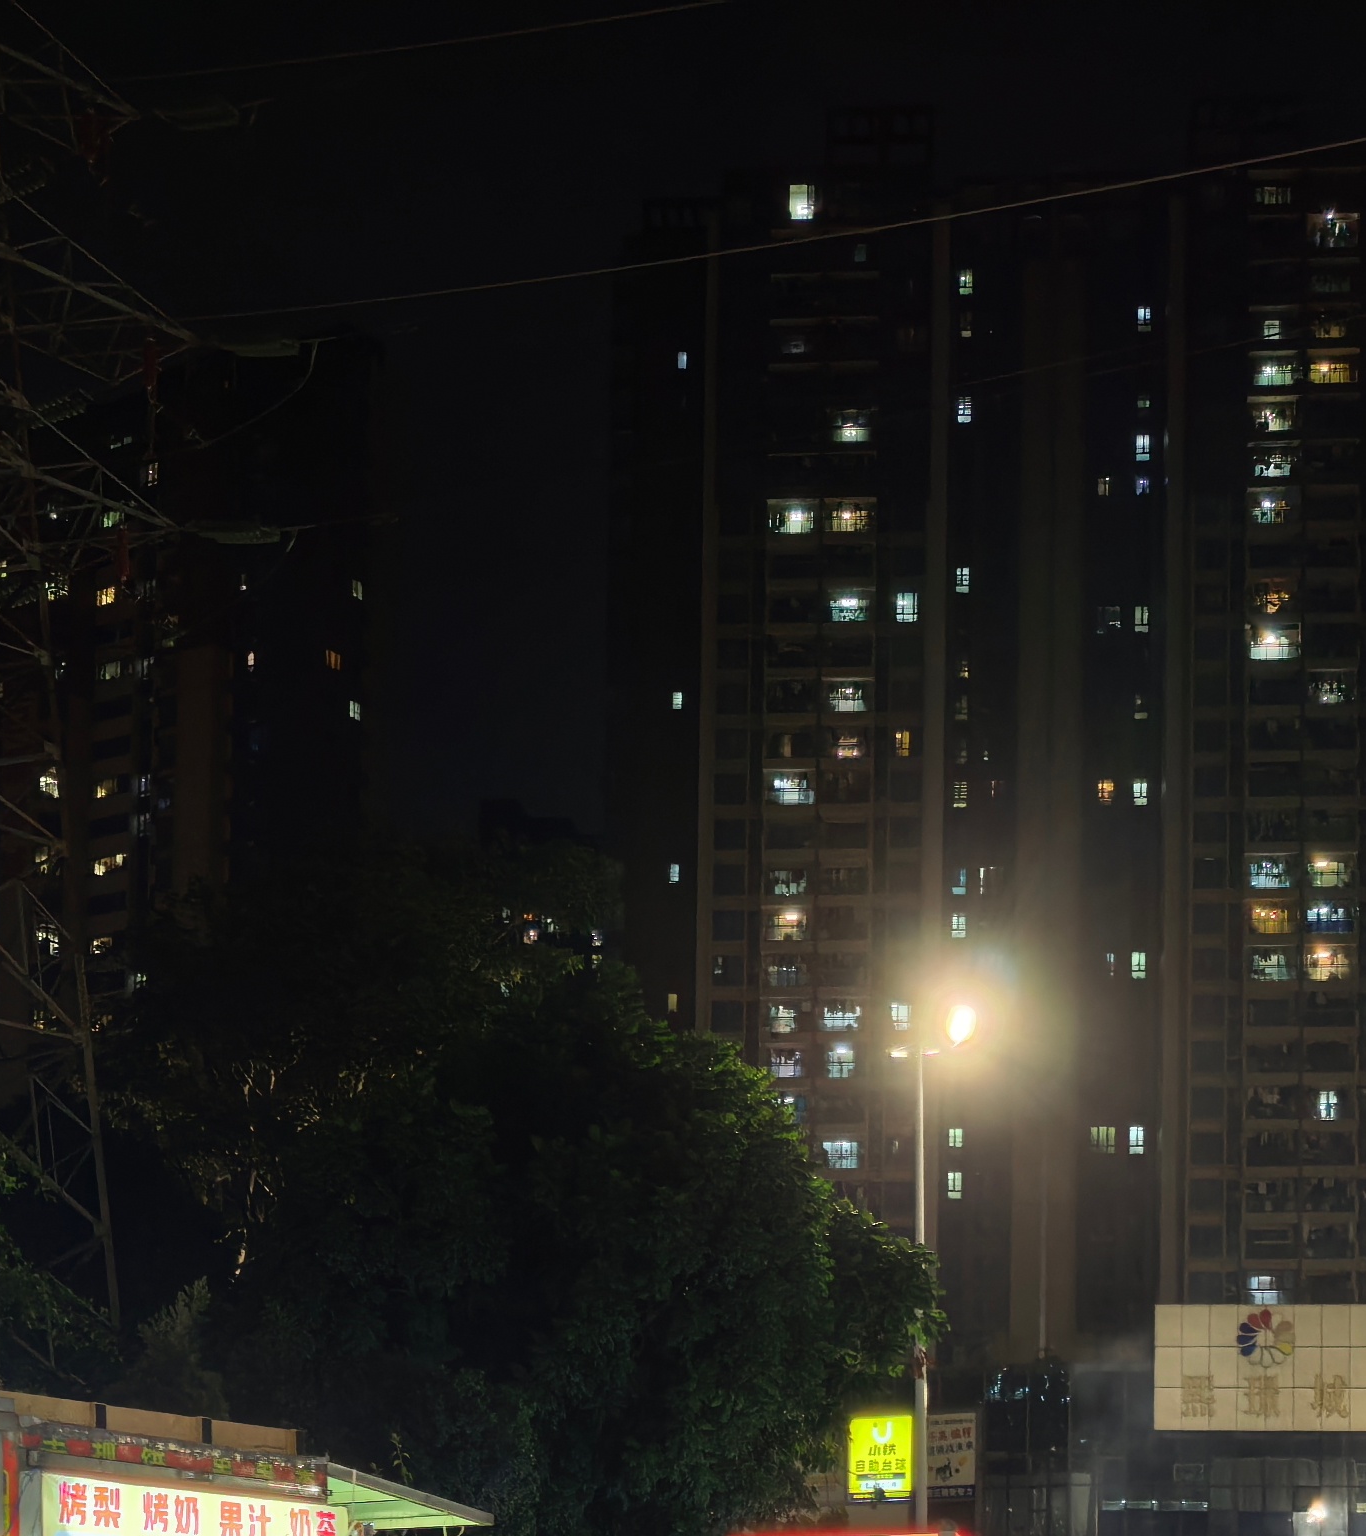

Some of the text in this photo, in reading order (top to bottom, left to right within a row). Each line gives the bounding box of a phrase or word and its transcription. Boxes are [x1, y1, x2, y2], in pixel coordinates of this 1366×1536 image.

[868, 1443, 897, 1457] 小铁
[855, 1458, 907, 1473] 自助台球
[59, 1481, 121, 1529] 烤梨
[143, 1491, 200, 1536] 烤奶
